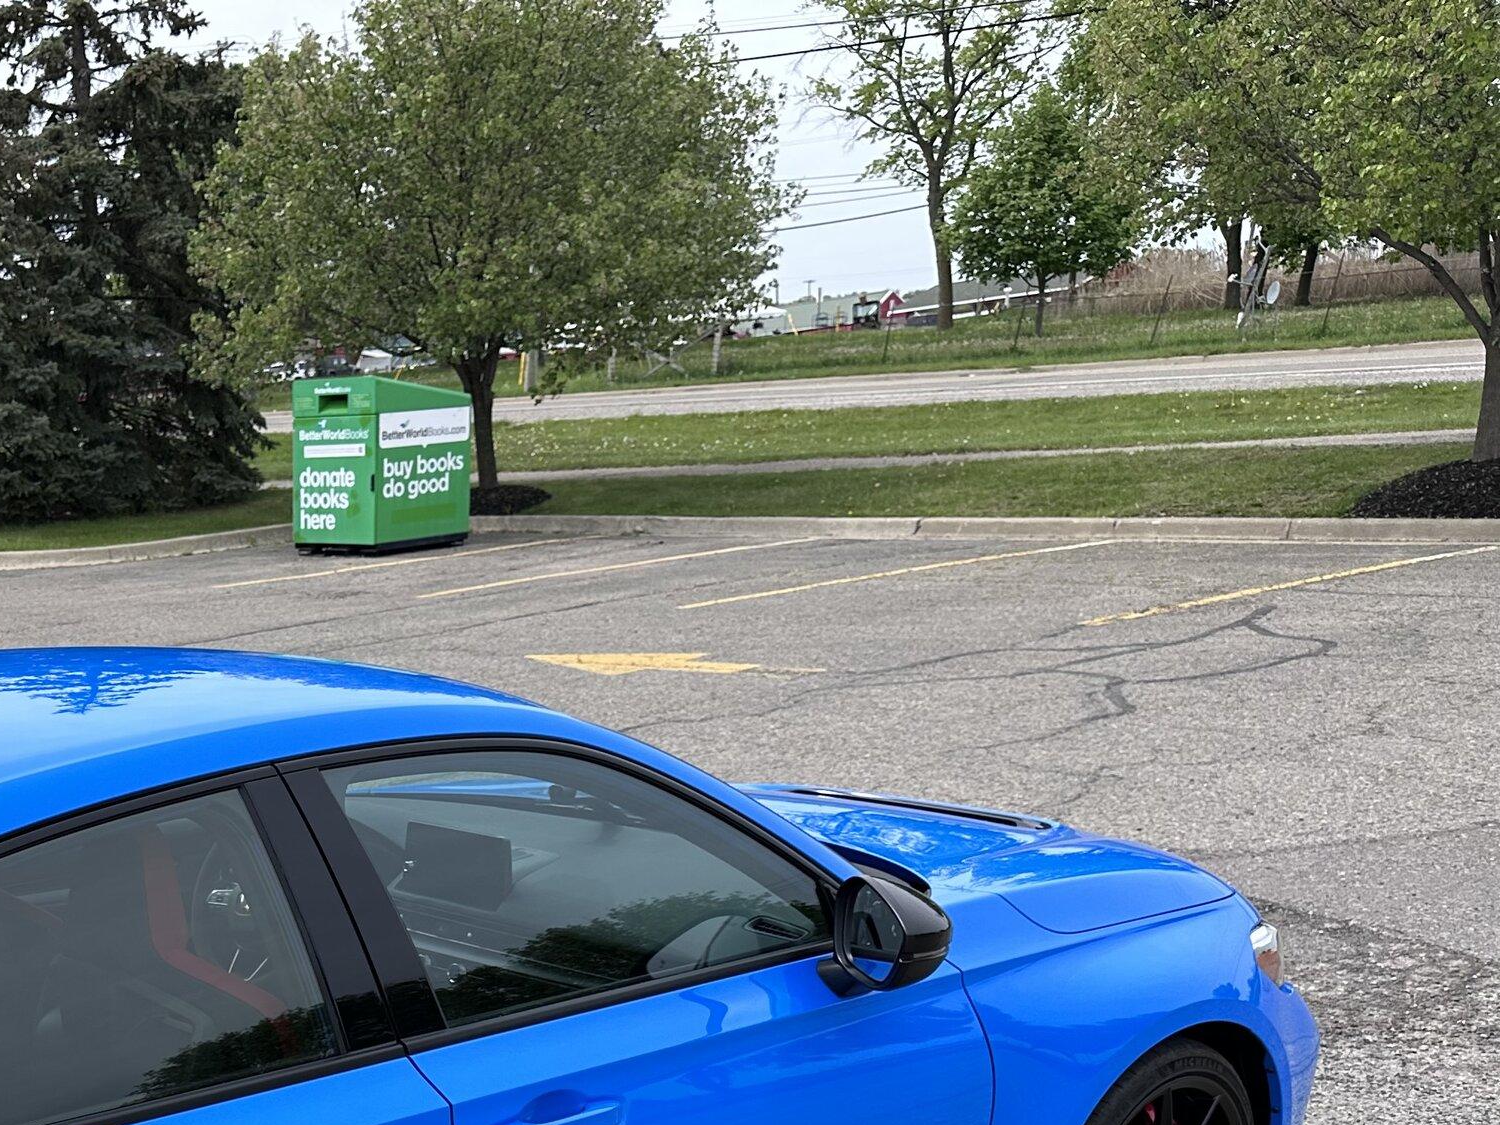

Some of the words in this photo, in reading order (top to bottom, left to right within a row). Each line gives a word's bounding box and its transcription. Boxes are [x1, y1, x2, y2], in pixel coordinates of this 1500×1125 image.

[383, 458, 414, 479] buy
[417, 452, 464, 474] books
[300, 467, 355, 487] donate
[383, 478, 405, 499] do
[408, 473, 449, 499] good
[300, 488, 349, 509] books
[300, 509, 336, 530] here
